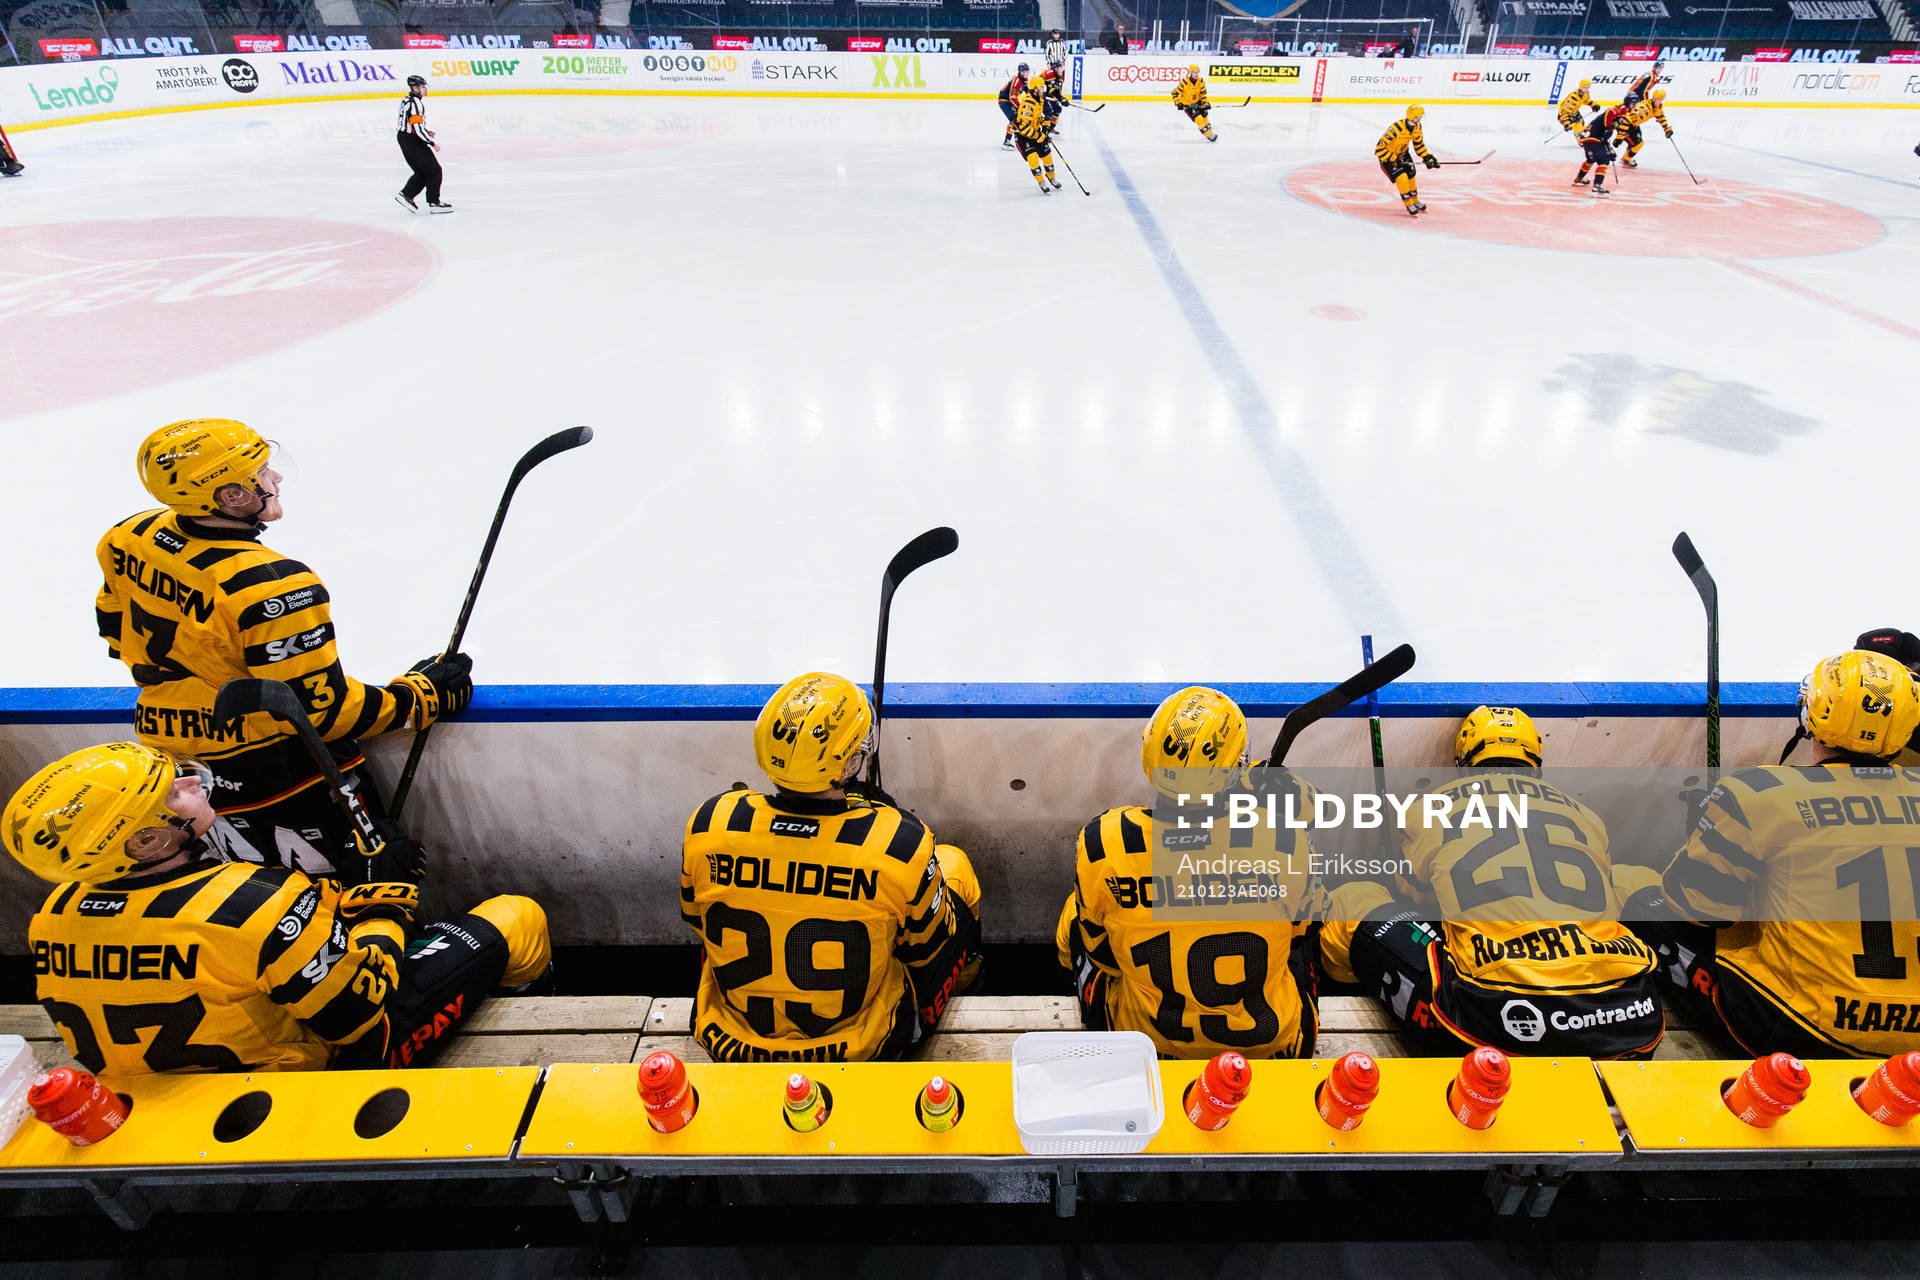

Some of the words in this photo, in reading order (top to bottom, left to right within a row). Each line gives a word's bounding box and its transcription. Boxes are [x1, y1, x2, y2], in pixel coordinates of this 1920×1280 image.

[101, 37, 146, 55] ALL
[287, 34, 326, 51] ALL
[449, 34, 483, 49] ALL
[752, 36, 783, 51] ALL
[851, 41, 882, 49] CCM
[885, 37, 915, 52] ALL
[982, 42, 1012, 50] CCM
[1015, 39, 1044, 54] ALL
[1529, 45, 1557, 59] ALL
[1657, 47, 1689, 60] ALL
[1789, 48, 1819, 62] ALL
[432, 59, 521, 77] SUBWAY
[542, 56, 584, 74] 200
[586, 56, 622, 66] METER
[156, 66, 192, 78] TRÖTT
[193, 64, 209, 76] PÅ
[587, 65, 628, 75] HOCKEY
[766, 65, 838, 80] STARK
[872, 54, 927, 88] XXL
[1210, 66, 1298, 76] HYRPOOLEN
[1481, 72, 1503, 82] ALL
[1505, 72, 1531, 82] OUT.
[155, 77, 218, 90] AMATÖRER?
[231, 79, 258, 88] PROFFS
[1350, 75, 1424, 84] BERGTORNET
[29, 77, 114, 111] Lendo
[1739, 86, 1759, 97] AB
[200, 466, 229, 484] CCM
[155, 531, 184, 549] CCM
[109, 542, 215, 624] BOLIDEN
[285, 590, 313, 603] Boliden
[287, 597, 314, 610] Electro
[304, 637, 322, 649] Kraft
[303, 672, 335, 710] 3
[1859, 729, 1877, 741] 15
[770, 756, 786, 769] 29
[1163, 768, 1177, 781] 19
[1854, 766, 1895, 782] CCM
[1794, 799, 1818, 830] NEW
[96, 818, 126, 852] CCM
[771, 820, 818, 835] CCM
[1163, 831, 1209, 847] CCM
[1442, 805, 1607, 914] 26
[715, 853, 879, 901] BOLIDEN
[1118, 872, 1280, 909] BOLIDEN
[79, 898, 126, 913] CCM
[1471, 921, 1653, 971] ROBERTSSON
[33, 940, 199, 981] BOLIDEN
[705, 902, 871, 1039] 29
[1131, 931, 1280, 1047] 19
[1550, 994, 1656, 1034] Contractor
